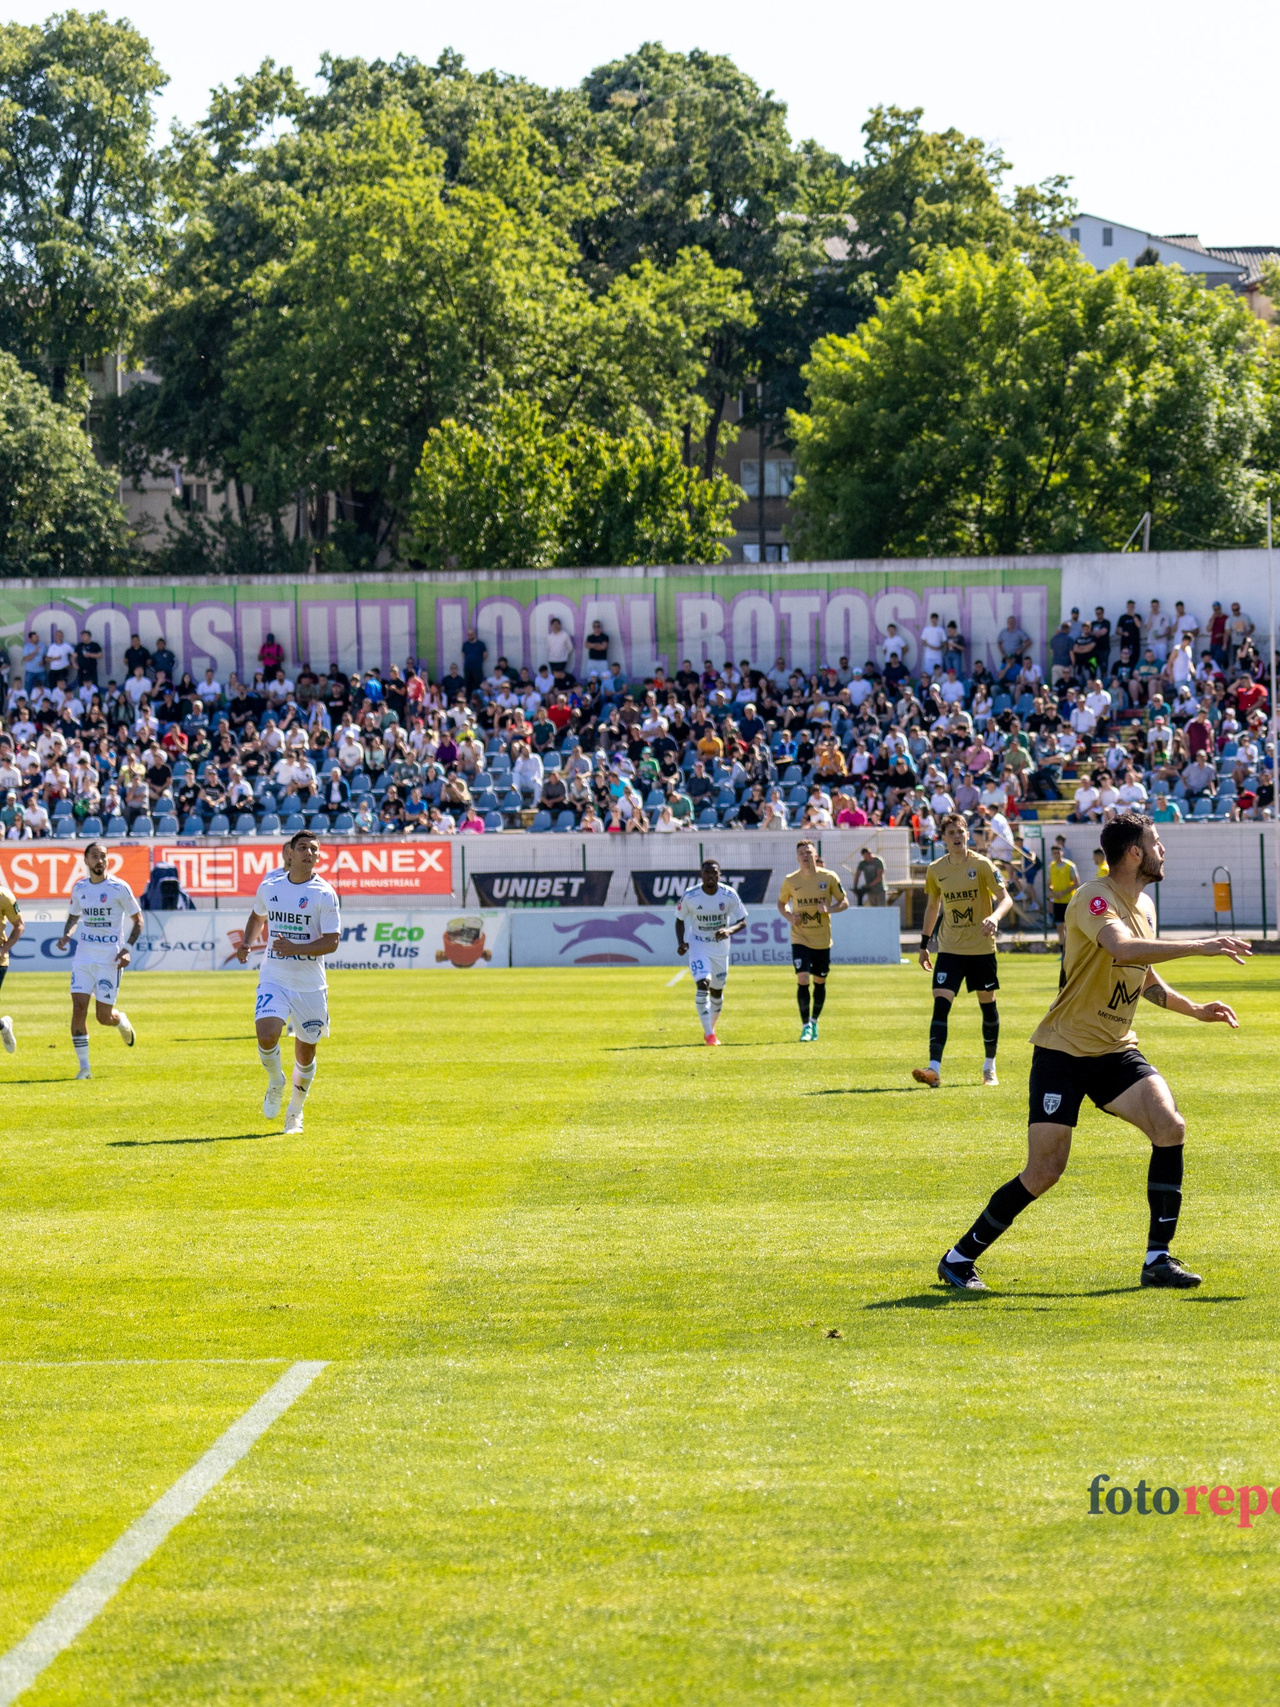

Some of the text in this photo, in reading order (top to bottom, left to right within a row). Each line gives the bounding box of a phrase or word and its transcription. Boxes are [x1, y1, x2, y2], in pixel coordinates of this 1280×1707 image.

[243, 849, 445, 875] MCANEX
[360, 878, 420, 888] INDUSTRIALE
[492, 877, 586, 899] UNIBET
[652, 876, 746, 898] UNIT
[943, 889, 979, 901] MAXBET
[268, 911, 312, 925] UNIBET
[81, 933, 118, 943] ELSACO
[373, 922, 425, 942] Eco
[136, 941, 215, 952] ELSACO
[378, 943, 419, 958] Plus
[691, 959, 704, 972] 83
[256, 993, 273, 1010] 27
